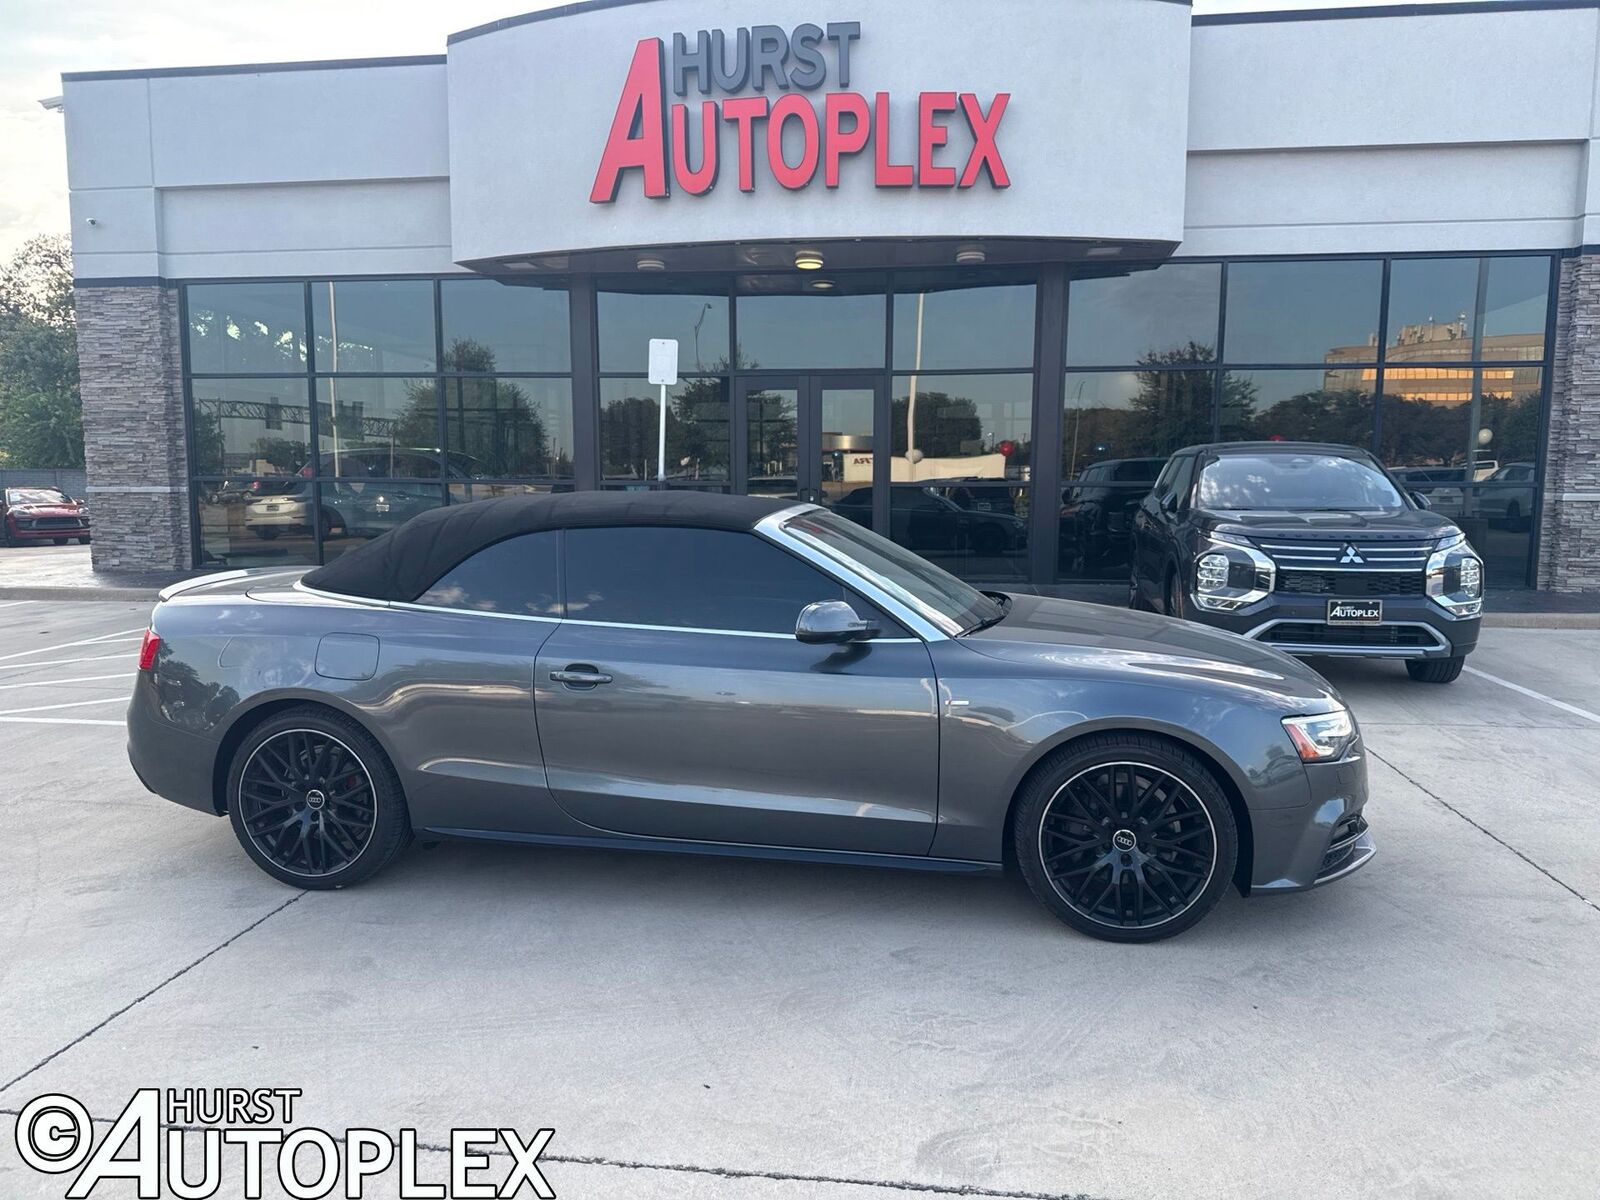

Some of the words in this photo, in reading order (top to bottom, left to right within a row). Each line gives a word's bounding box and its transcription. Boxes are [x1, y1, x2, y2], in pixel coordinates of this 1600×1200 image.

[673, 21, 861, 97] HURST
[589, 37, 1011, 204] AUTOPLEX
[1330, 605, 1379, 617] AUTOPLEX
